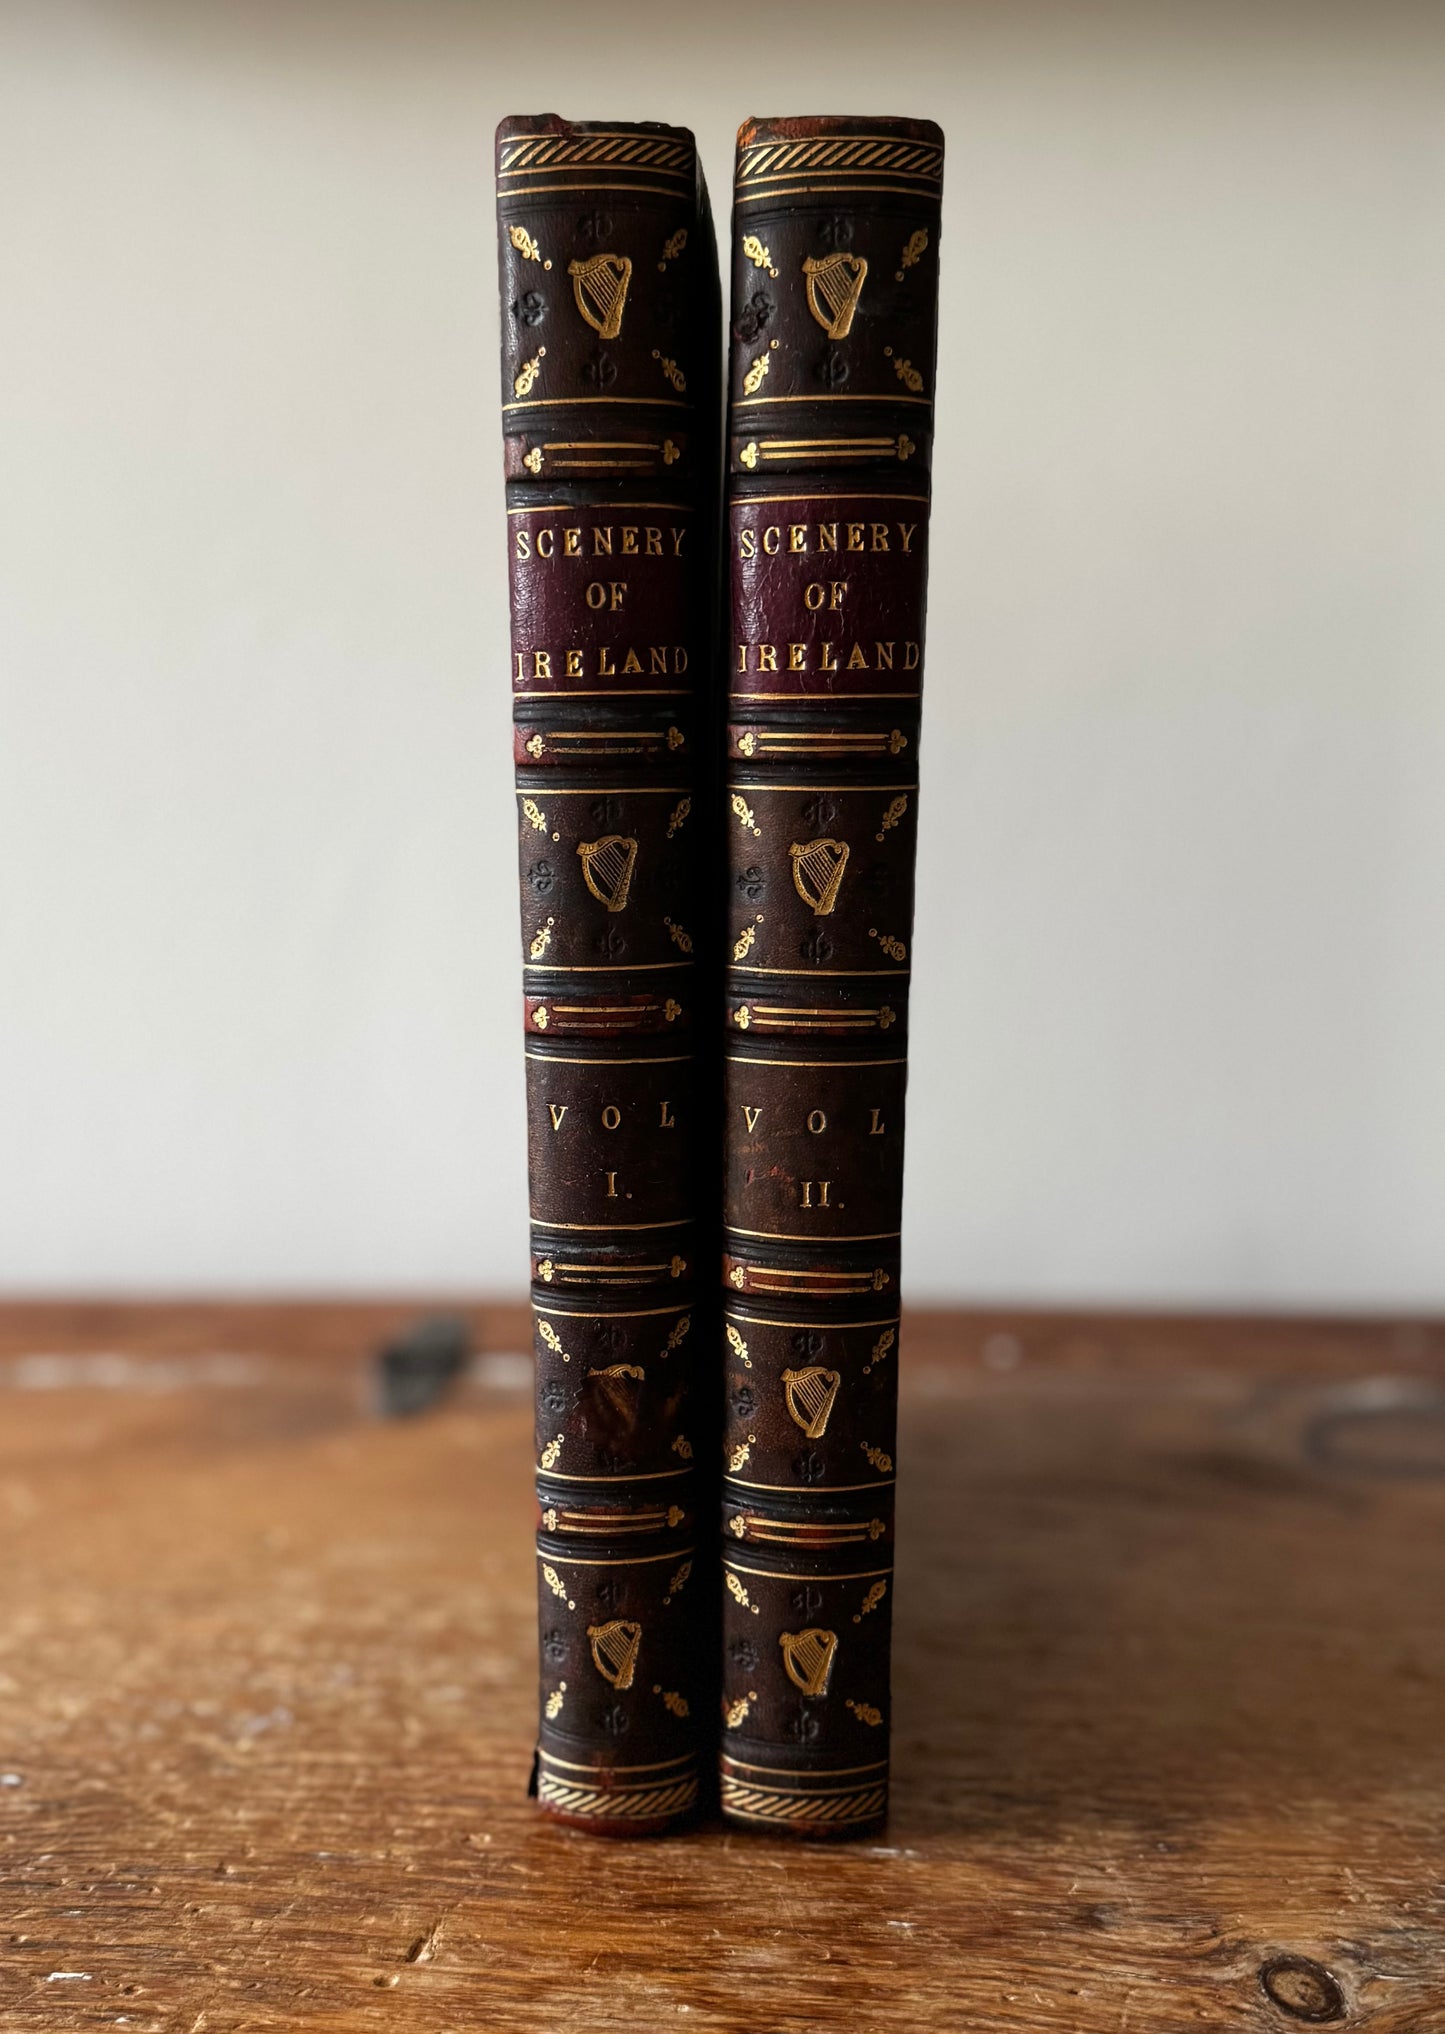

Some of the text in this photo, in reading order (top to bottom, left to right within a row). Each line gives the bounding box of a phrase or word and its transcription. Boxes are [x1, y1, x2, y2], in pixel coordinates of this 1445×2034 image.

[516, 526, 687, 560] SCENERY
[739, 523, 918, 558] SCENERY
[586, 582, 628, 611] OF
[804, 582, 849, 611] OF
[515, 646, 689, 681] IRELAND
[738, 641, 921, 673] IRELAND
[605, 1171, 633, 1199] I.
[800, 1181, 846, 1209] II.
